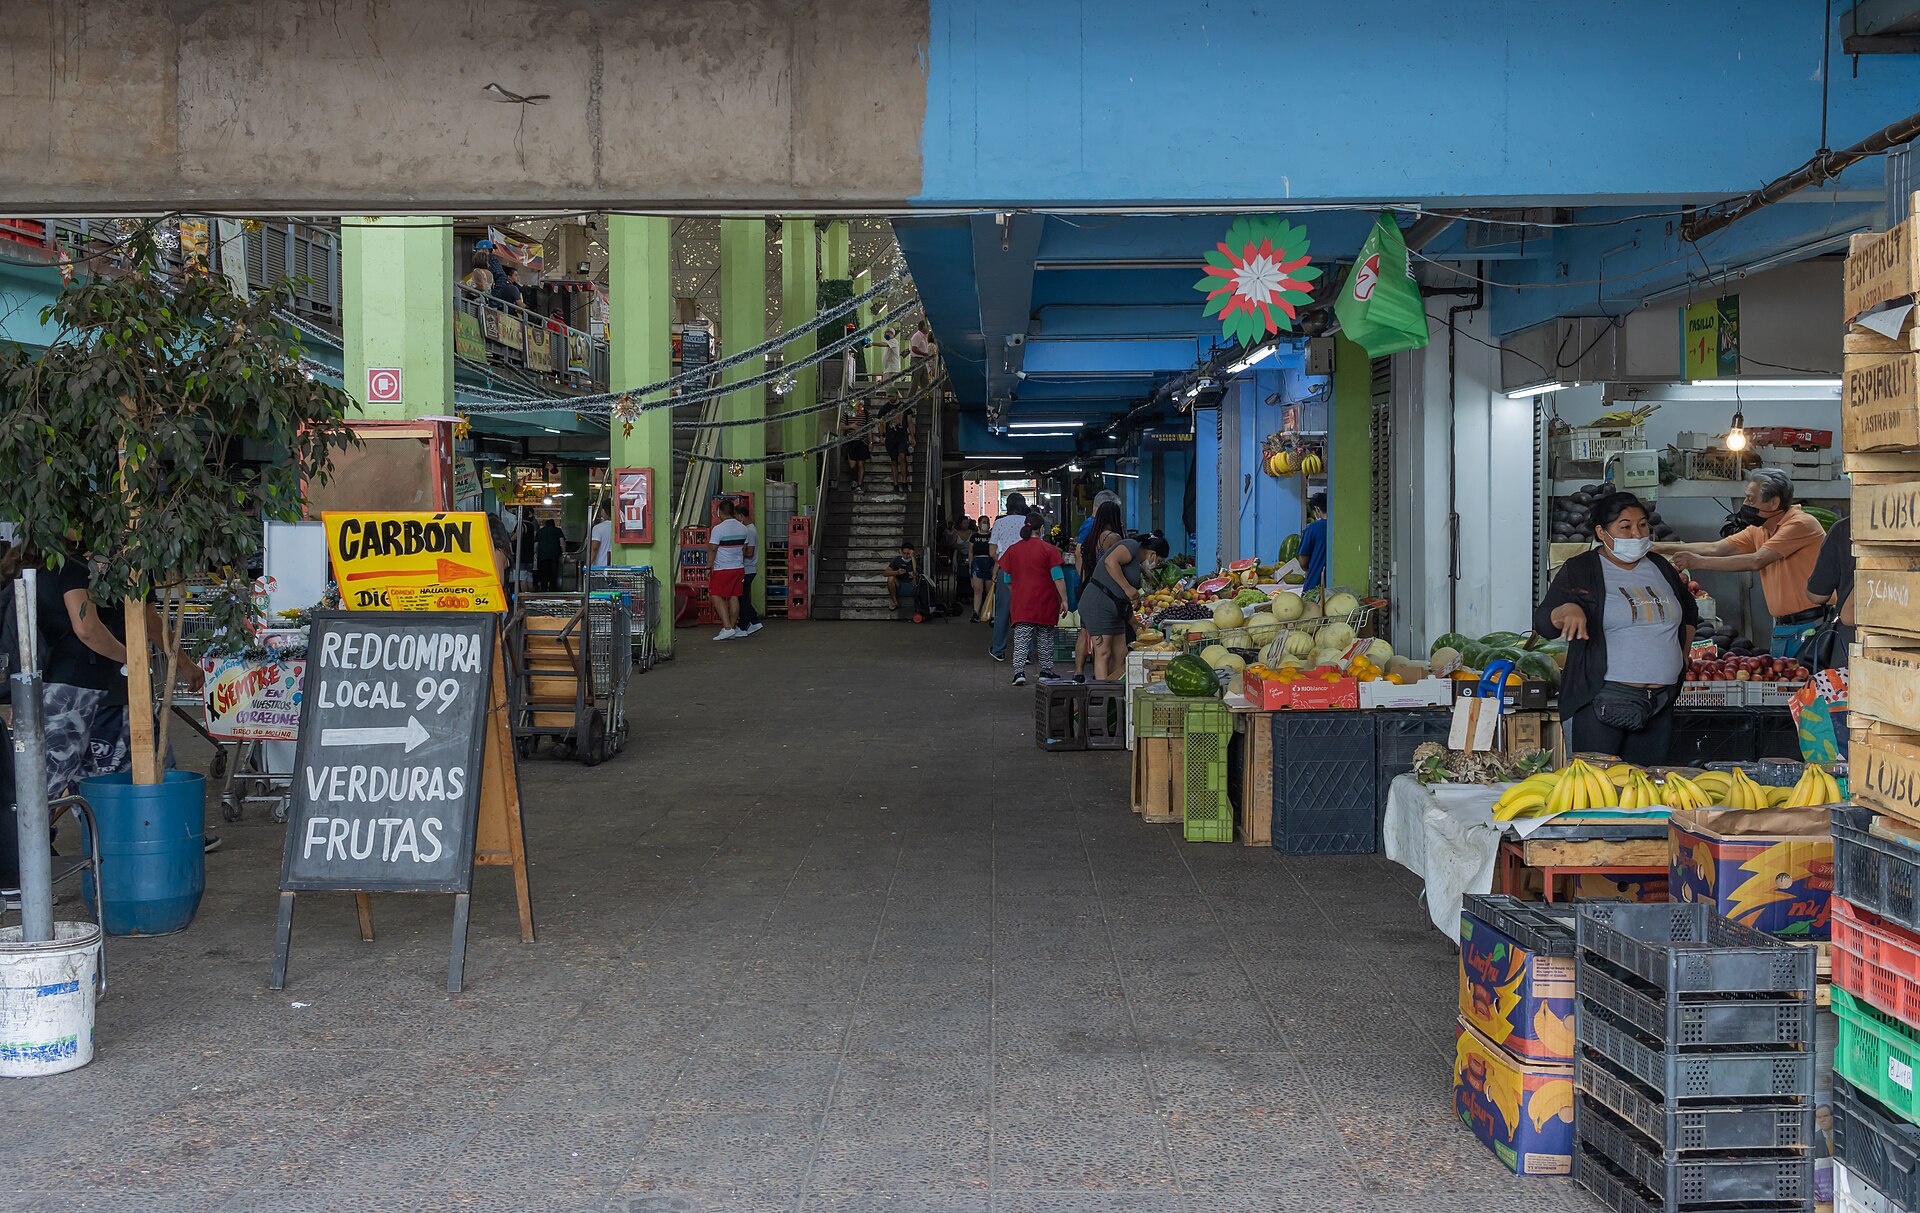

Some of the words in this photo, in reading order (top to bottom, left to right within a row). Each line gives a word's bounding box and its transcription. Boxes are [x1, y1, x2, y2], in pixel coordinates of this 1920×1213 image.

[1850, 226, 1902, 291] ESPIFRUT
[1689, 316, 1714, 333] PASILLO
[1699, 336, 1705, 364] 1
[1850, 359, 1908, 408] ESPIFRUT
[1861, 412, 1888, 435] LASTRA
[339, 514, 472, 562] CARBÓN
[475, 597, 489, 606] 94
[320, 632, 482, 673] REDCOMPRA
[251, 699, 292, 711] NUESTROS
[264, 689, 285, 698] EN
[318, 680, 406, 709] LOCAL
[415, 676, 460, 715] 99
[264, 730, 292, 738] MOLINA
[306, 765, 465, 803] VERDURAS
[303, 817, 443, 863] FRUTAS
